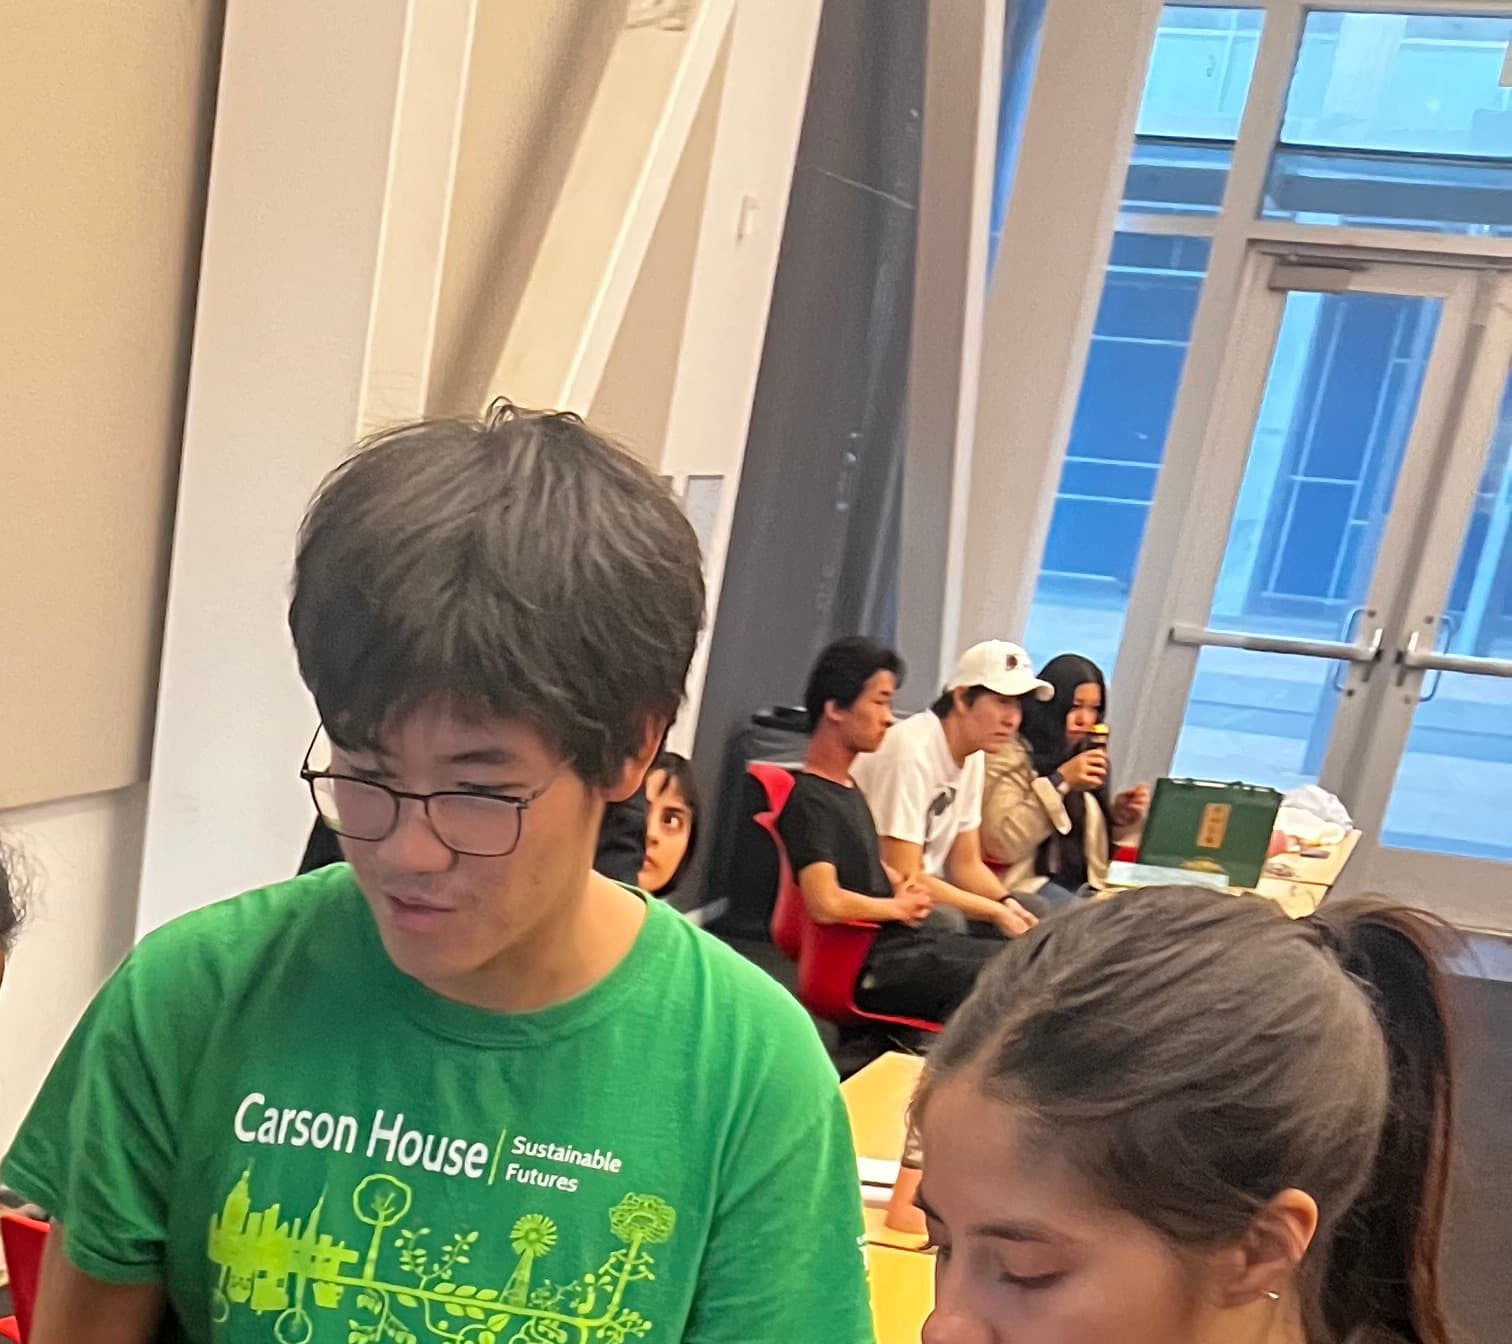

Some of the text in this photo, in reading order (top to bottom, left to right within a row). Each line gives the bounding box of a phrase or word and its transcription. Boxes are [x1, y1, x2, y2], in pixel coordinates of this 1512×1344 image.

[233, 1092, 489, 1178] Carson House
[510, 1135, 623, 1174] Sustainable
[505, 1163, 579, 1193] Futures
